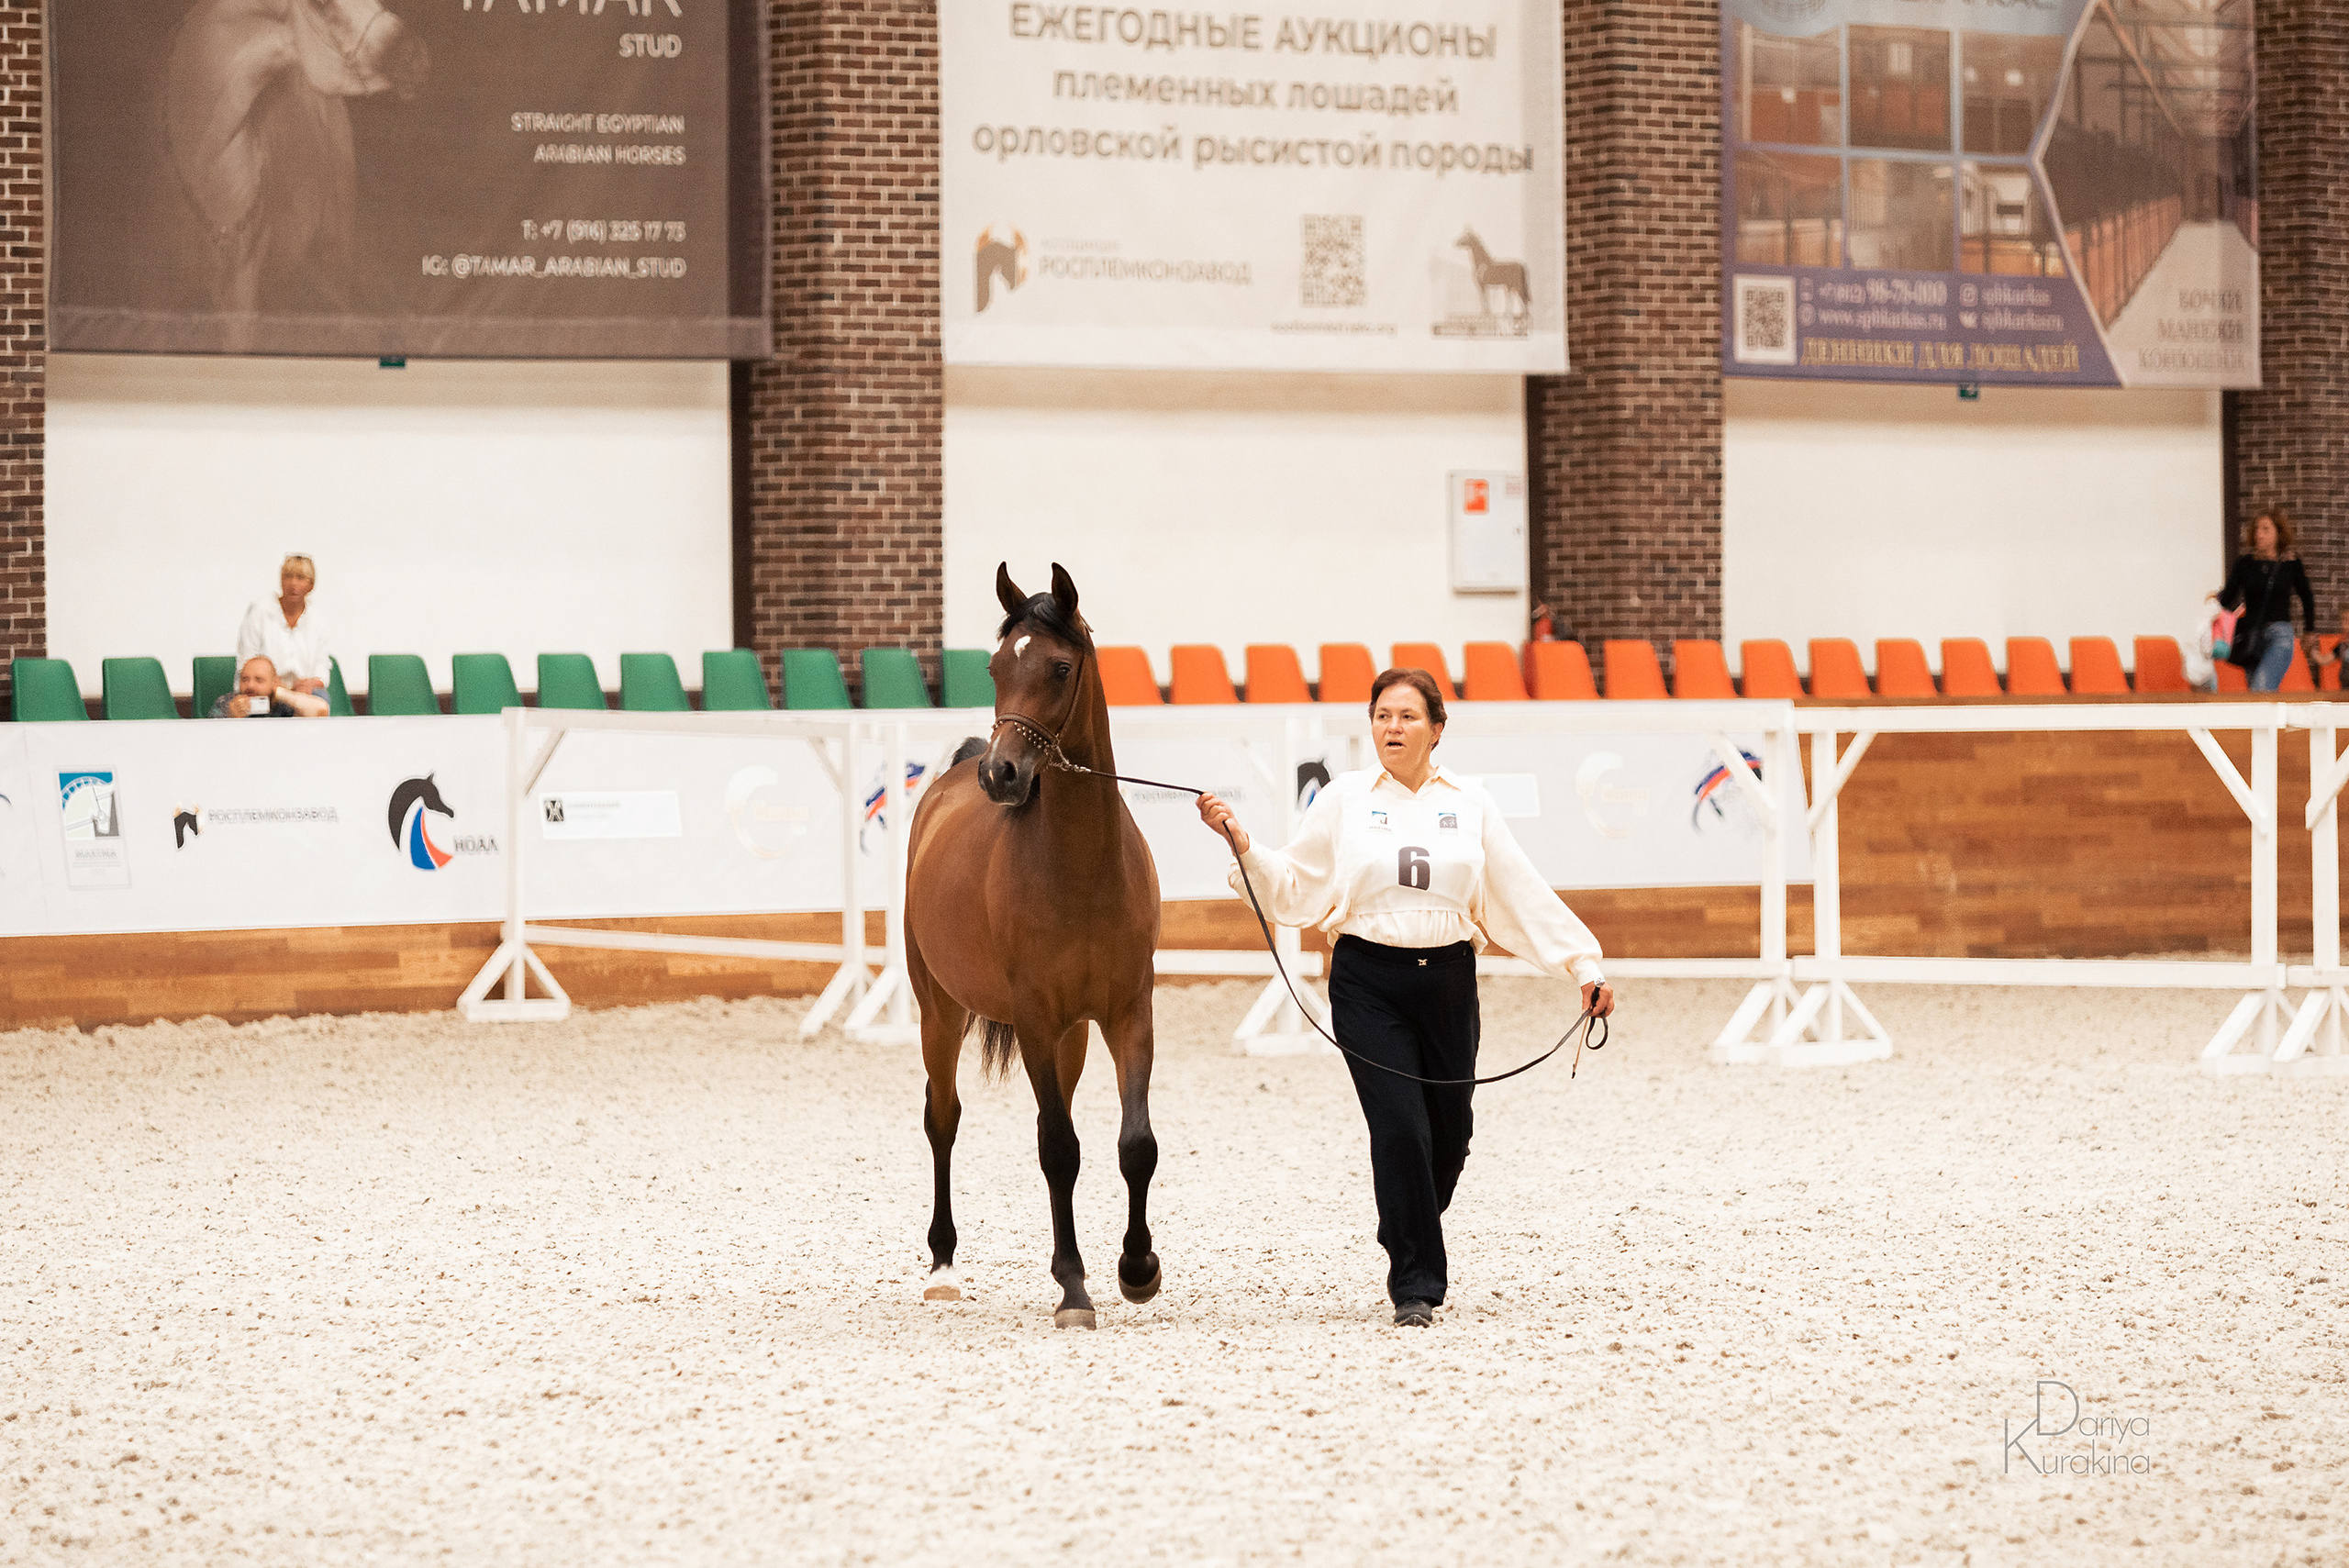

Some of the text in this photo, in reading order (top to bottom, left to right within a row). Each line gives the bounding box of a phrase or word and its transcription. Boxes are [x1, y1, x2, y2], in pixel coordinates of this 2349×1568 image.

[618, 33, 683, 59] STUD
[1011, 3, 1497, 61] ЕЖЕГОДНЫЕ АУКЦИОНЫ
[1053, 70, 1460, 119] племенных лошадей
[510, 111, 685, 135] STRAIGHT EGYPTIAN
[533, 143, 687, 166] ARABIAN HORSES
[971, 122, 1535, 178] орловской рысистой породы
[451, 252, 687, 280] @TAMAR_ARABIAN_STUD
[1397, 846, 1431, 891] 6
